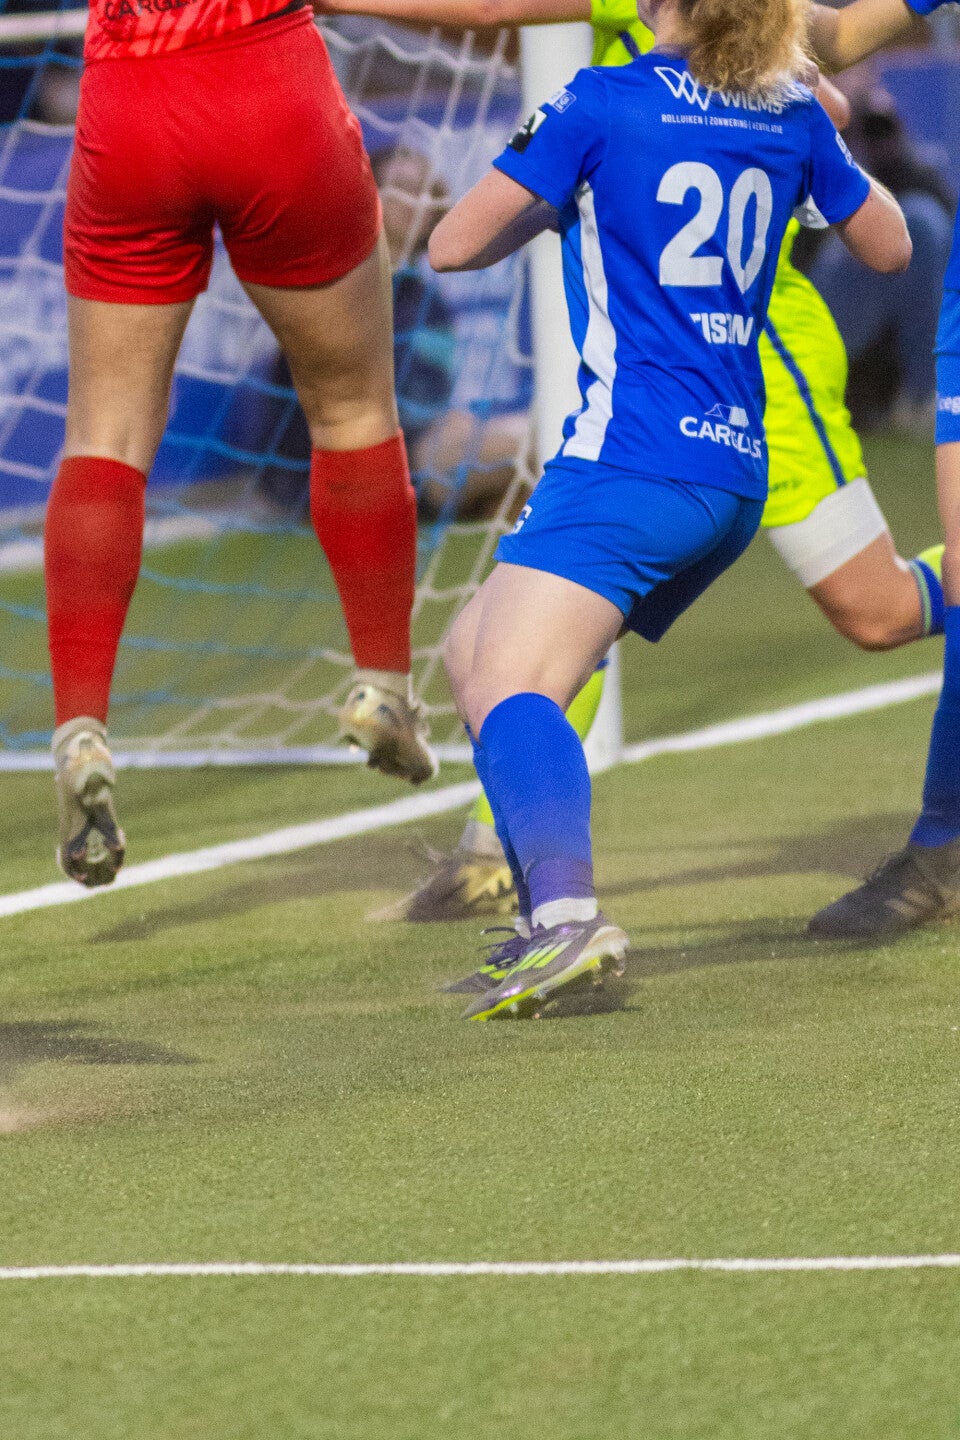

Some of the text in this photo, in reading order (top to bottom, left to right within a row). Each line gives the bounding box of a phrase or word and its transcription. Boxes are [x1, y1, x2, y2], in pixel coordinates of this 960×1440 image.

[661, 114, 703, 125] ROLLUIKEN
[709, 116, 747, 129] ZONWERING
[656, 161, 773, 295] 20
